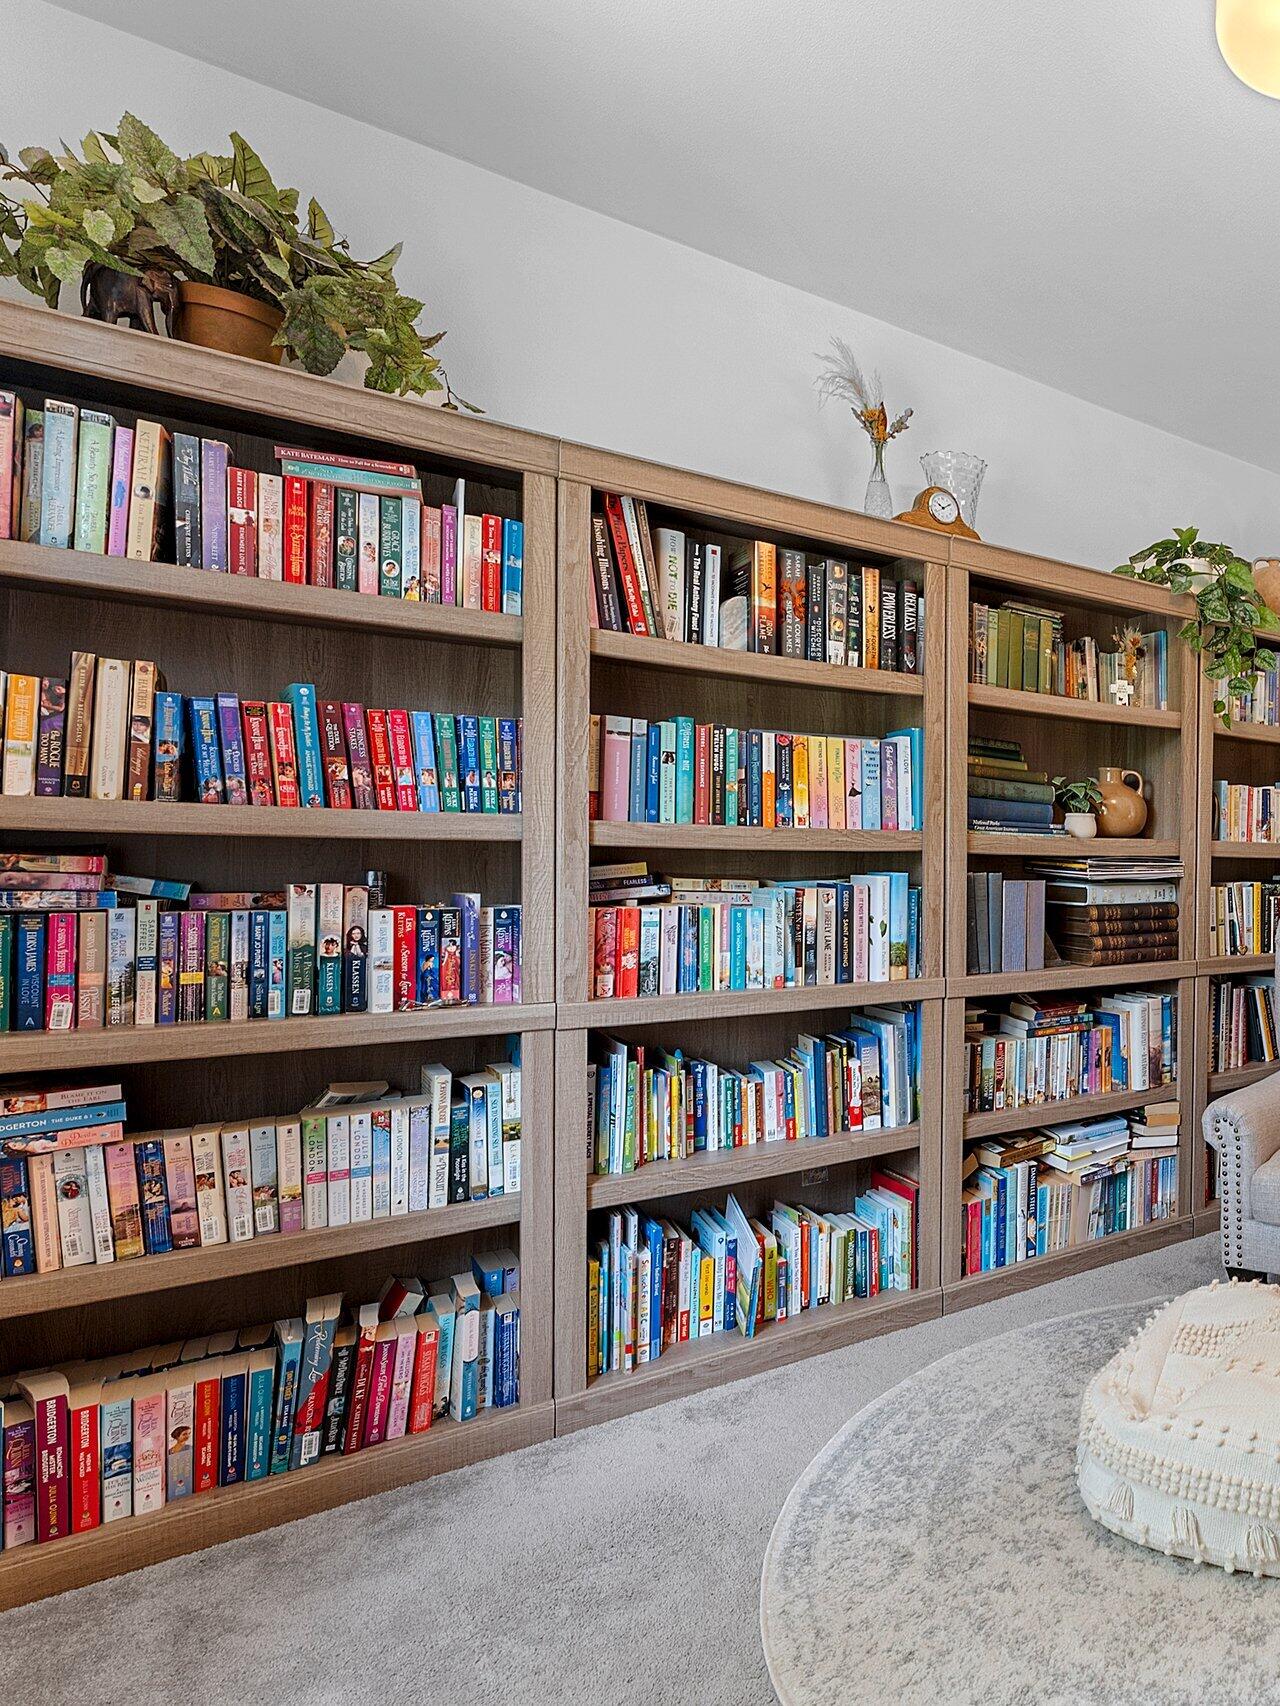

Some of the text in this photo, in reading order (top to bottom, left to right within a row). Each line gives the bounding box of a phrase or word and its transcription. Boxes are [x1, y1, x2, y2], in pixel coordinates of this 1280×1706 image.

[136, 431, 150, 480] KETURAH
[301, 452, 335, 462] BATEMAN
[382, 523, 391, 558] BURROWES
[391, 530, 400, 552] GRACE
[592, 519, 611, 590] Dissolving Illusions
[616, 542, 629, 572] Papers
[668, 555, 678, 580] NOT
[670, 580, 676, 590] TO
[692, 571, 701, 585] Real
[667, 591, 678, 611] DIE
[691, 586, 701, 612] Anthony
[904, 592, 916, 632] RECKLESS
[691, 612, 701, 631] Fauci
[882, 591, 895, 639] POWERLESS
[138, 678, 148, 710] HATCHER
[50, 741, 60, 768] ROGUE
[356, 728, 365, 758] PRINCESS
[131, 747, 146, 776] belonging
[139, 920, 147, 952] JEFFRIES
[397, 912, 406, 938] KLEYPAS
[406, 917, 414, 932] LISA
[442, 913, 452, 936] KLEYPAS
[496, 927, 505, 949] KLEYPAS
[796, 932, 802, 943] ME
[25, 931, 37, 972] ELOISA JAMES
[56, 928, 68, 973] SABRINA JEFFRIES
[119, 939, 127, 957] DUKE
[421, 929, 432, 952] KLEYPAS
[86, 949, 96, 972] JEFFRIES
[293, 952, 302, 973] MOST
[22, 978, 30, 1004] IN LOVE
[31, 974, 40, 1008] VISCOUNT
[352, 960, 361, 994] KLASSEN
[80, 989, 92, 1021] PASSION
[111, 967, 120, 1024] SABRINA JEFFRIES
[60, 1091, 84, 1100] BLAME
[396, 1118, 404, 1160] JULIA LONDON
[435, 1163, 446, 1192] PURSUIT
[308, 1324, 327, 1383] Redeeming Love
[440, 1345, 449, 1368] WIGGS
[420, 1351, 432, 1396] SUSAN WIGGS
[46, 1400, 57, 1445] BRIDGERTON
[305, 1392, 315, 1425] FRANCINE
[350, 1378, 367, 1450] DUKE SCARLETT SCOTT
[81, 1410, 89, 1449] BRIDGERTON
[48, 1504, 56, 1525] QUINN
